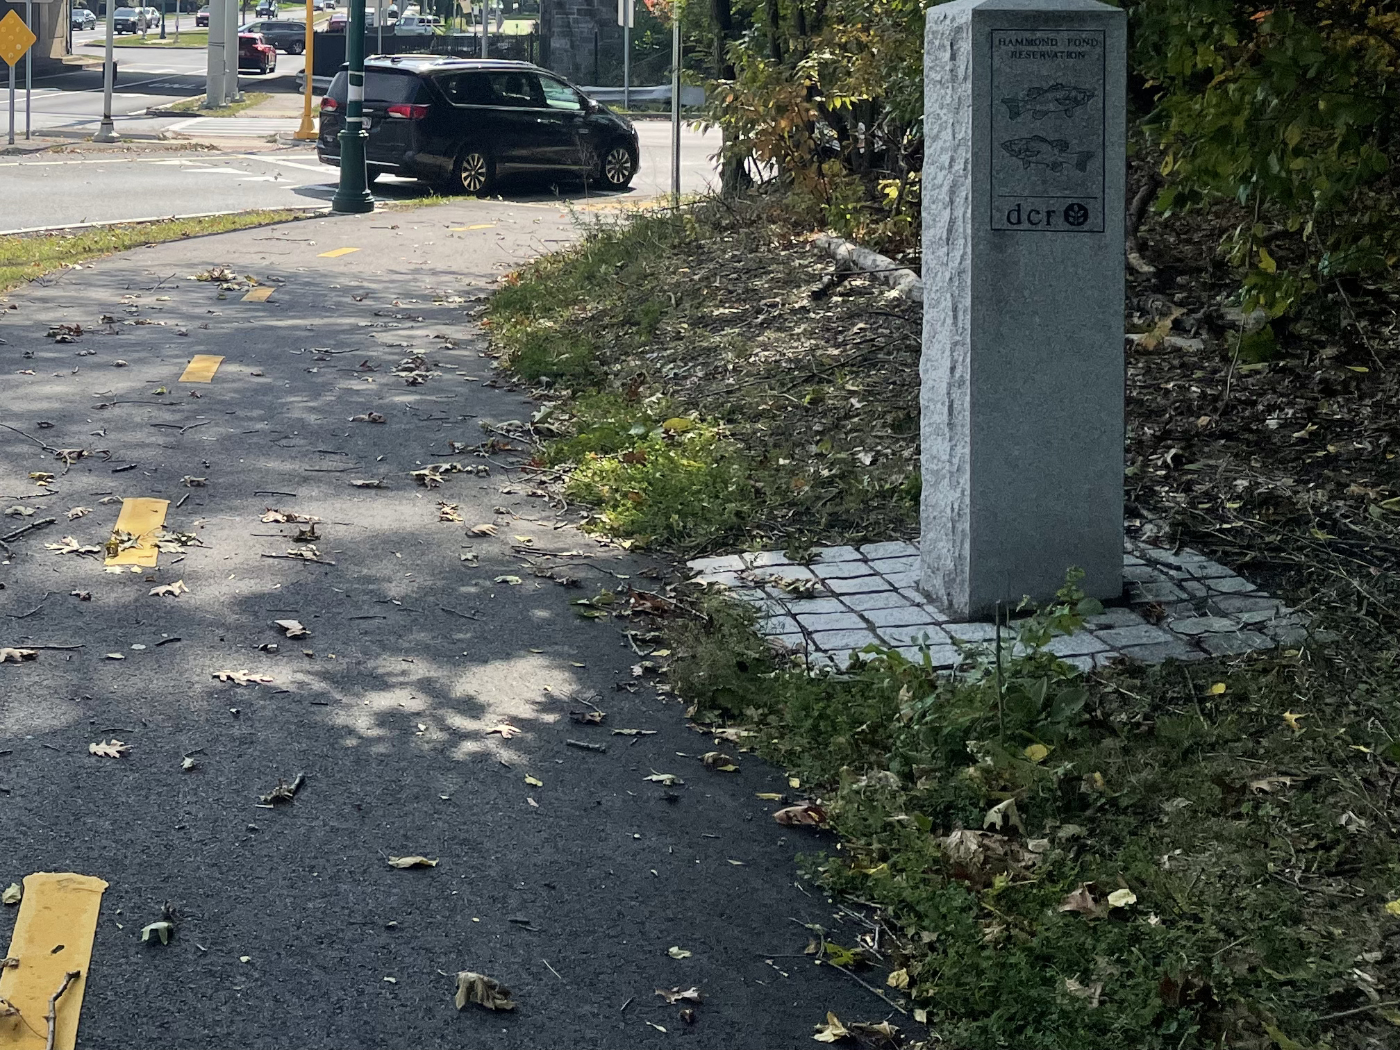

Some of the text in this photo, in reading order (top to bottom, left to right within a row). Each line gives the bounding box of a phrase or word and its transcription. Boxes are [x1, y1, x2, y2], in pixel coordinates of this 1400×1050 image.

[999, 37, 1098, 47] HAMMOND POND
[1010, 50, 1086, 60] RESERVATION
[1006, 203, 1056, 226] dcr
